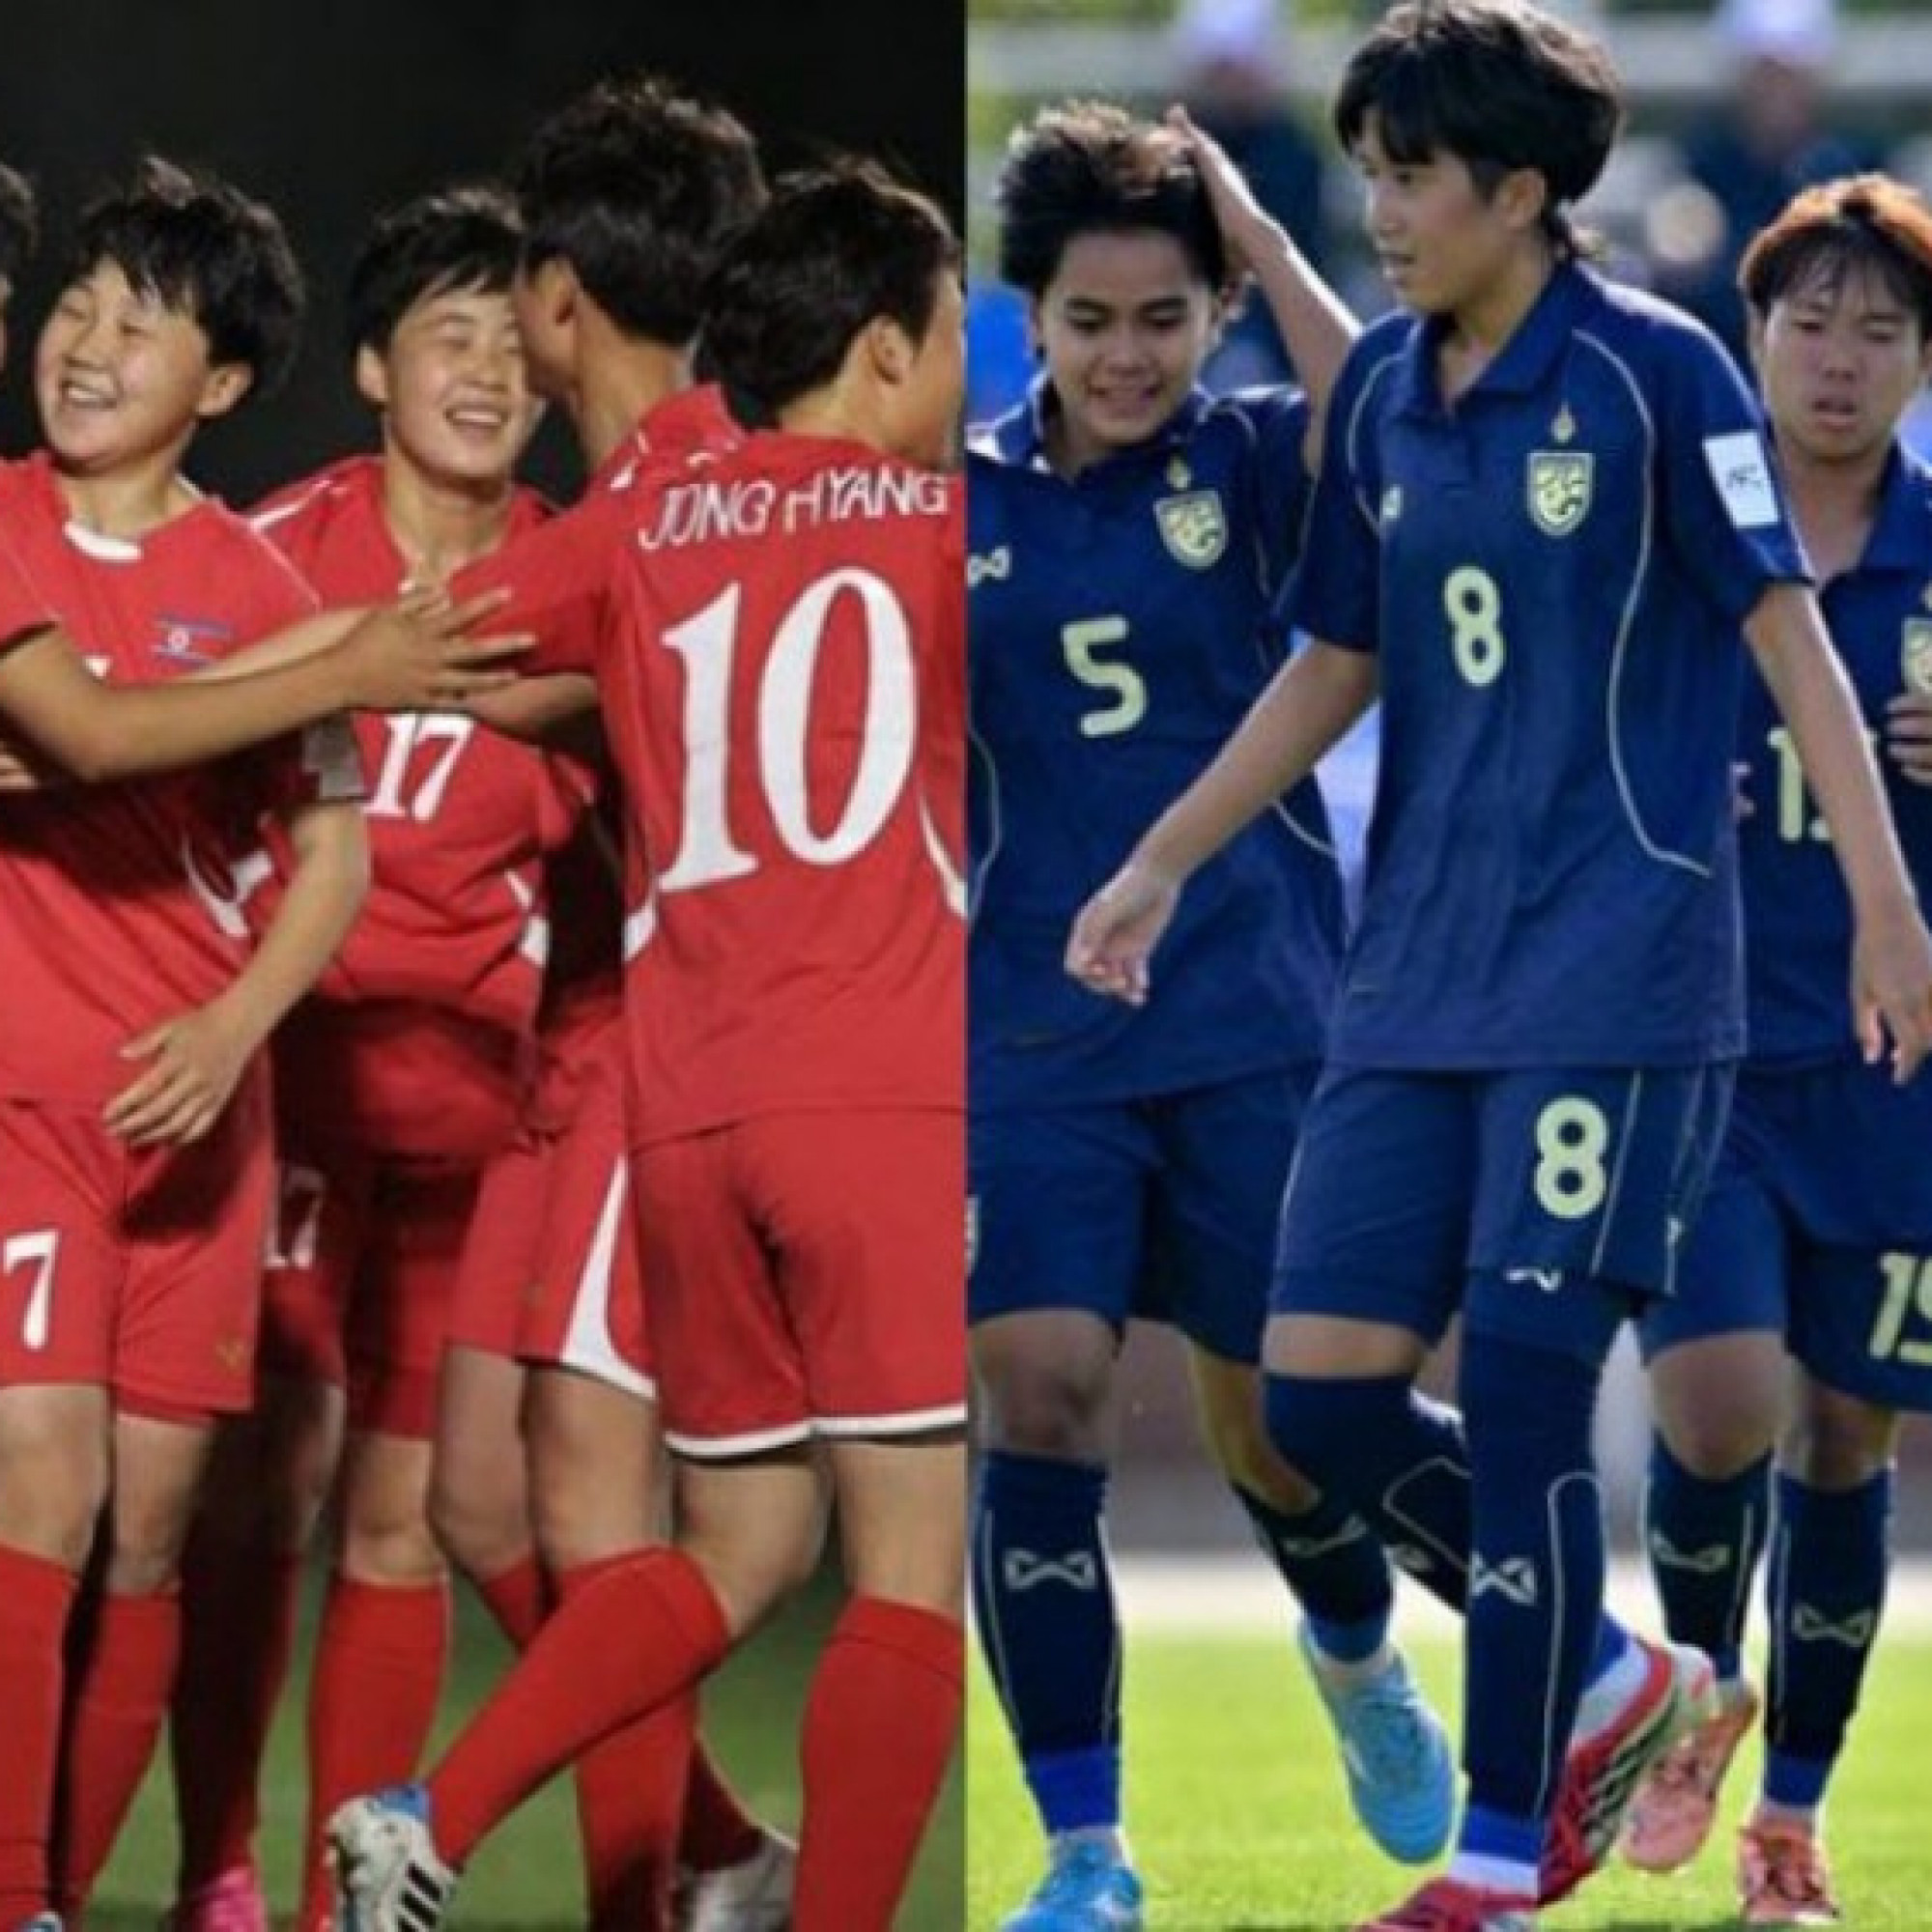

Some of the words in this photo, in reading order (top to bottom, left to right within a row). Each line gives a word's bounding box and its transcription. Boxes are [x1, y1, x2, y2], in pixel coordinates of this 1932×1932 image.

[783, 464, 948, 535] HYANG
[1061, 614, 1147, 738] 5
[1444, 564, 1504, 687] 8
[363, 714, 473, 822] 17
[660, 567, 919, 893] 10
[1767, 726, 1880, 842] 1
[1534, 1094, 1606, 1219] 8
[2, 1230, 58, 1350] 7
